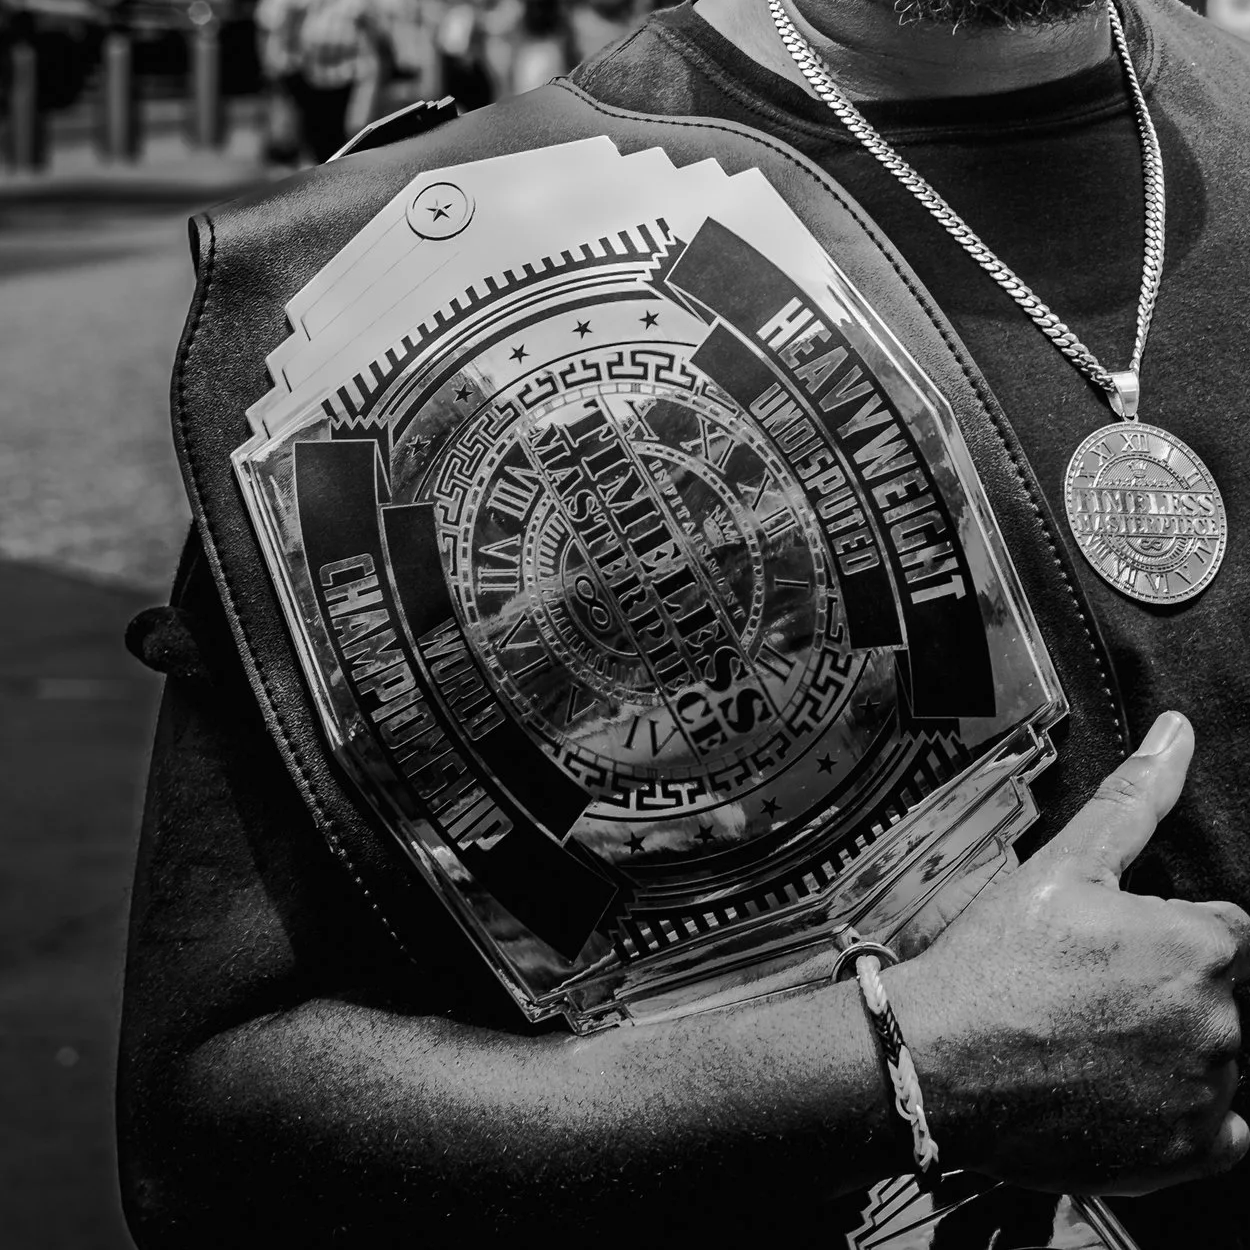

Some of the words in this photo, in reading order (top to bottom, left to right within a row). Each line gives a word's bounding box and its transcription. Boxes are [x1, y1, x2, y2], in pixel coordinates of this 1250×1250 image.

[528, 421, 728, 751] MASTERPIECE
[562, 398, 773, 735] TIMELESS
[749, 382, 880, 575] UNDISPUTED
[756, 296, 967, 605] HEAVYWEIGHT
[1075, 489, 1217, 517] TIMELESS
[319, 552, 515, 851] CHAMPIONSHIP
[417, 617, 506, 741] WORLD
